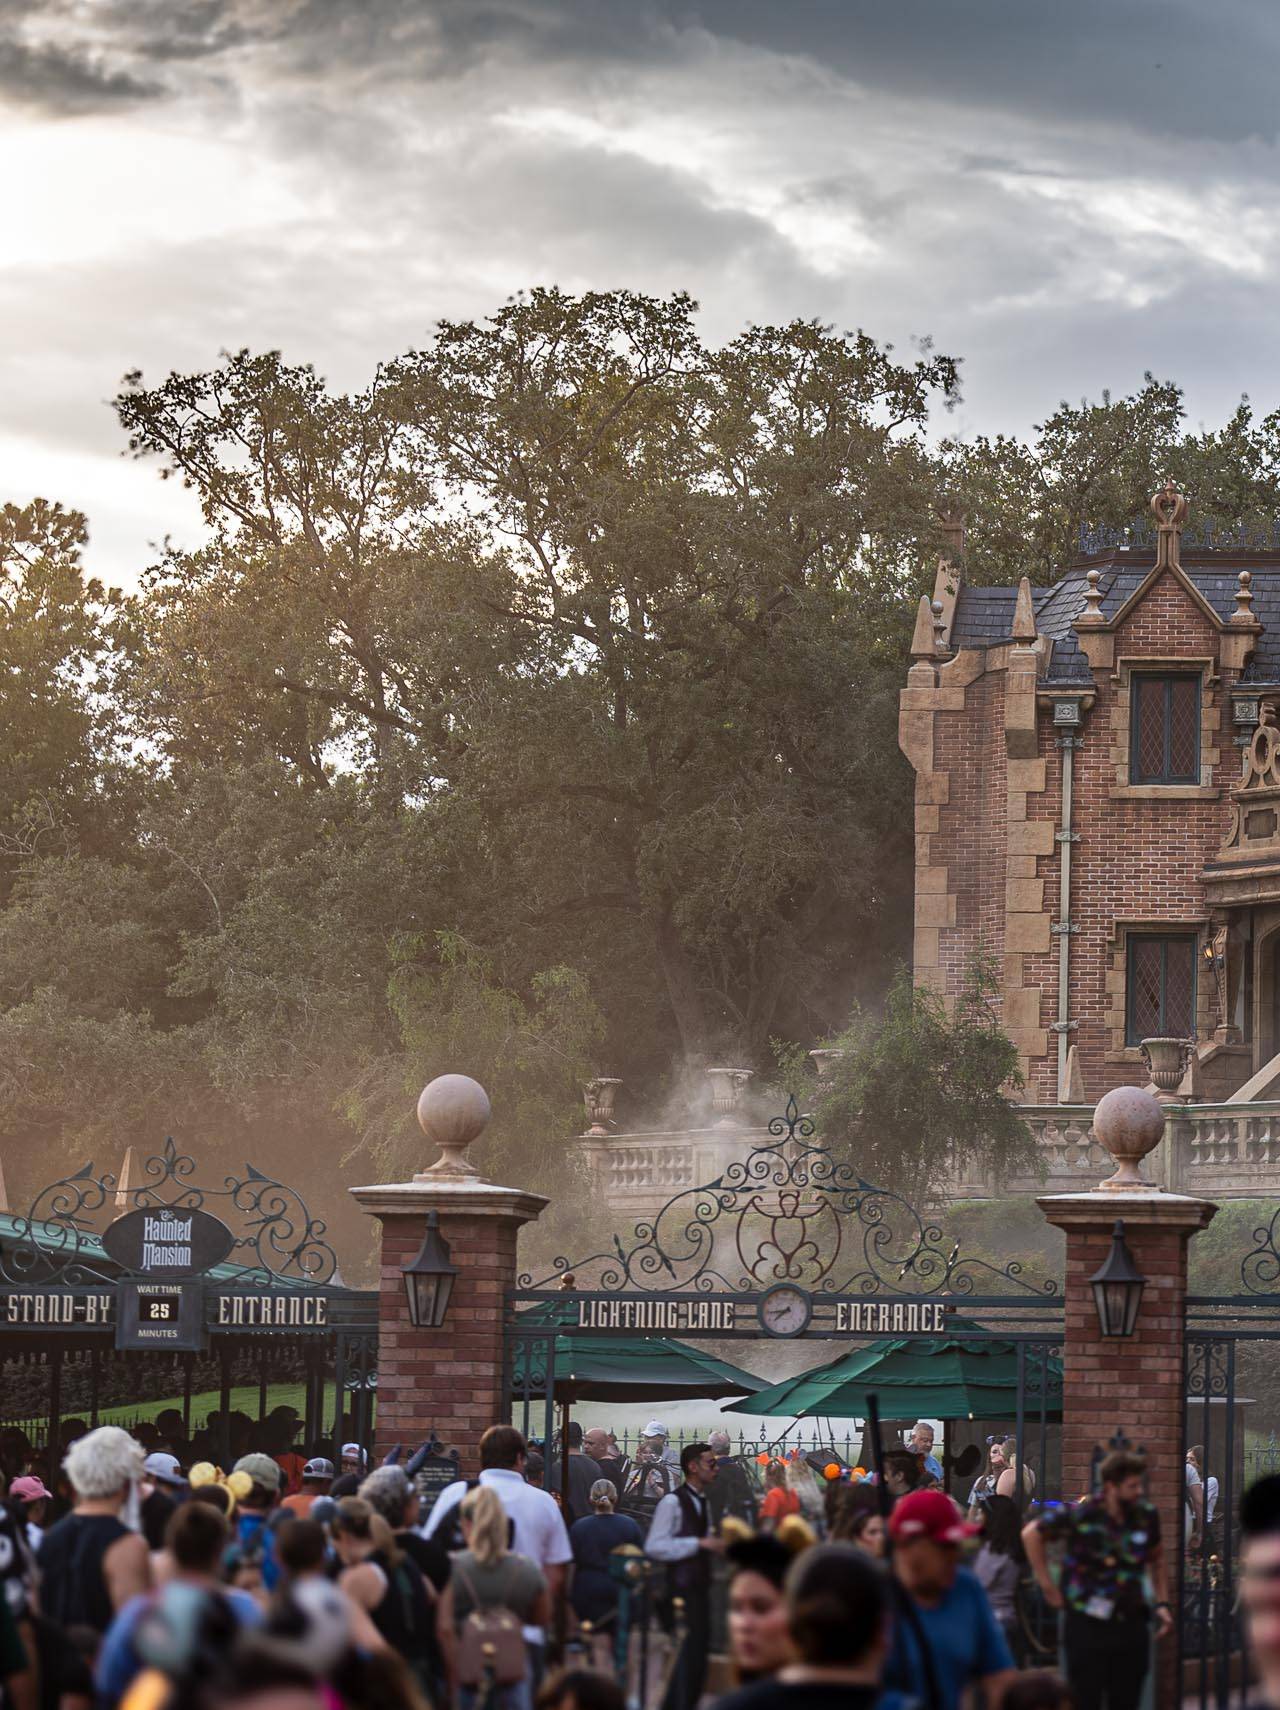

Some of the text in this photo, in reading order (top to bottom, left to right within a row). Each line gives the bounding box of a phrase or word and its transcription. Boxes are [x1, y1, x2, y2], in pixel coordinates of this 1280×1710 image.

[143, 1216, 193, 1242] Haunted
[140, 1242, 192, 1271] Mansion
[137, 1285, 182, 1294] WAIT TIME
[7, 1294, 111, 1323] STAND-BY
[150, 1303, 170, 1319] 25
[218, 1296, 327, 1325] ENTRANCE
[578, 1300, 734, 1329] LIGHTNING LANE
[836, 1303, 945, 1332] ENTRANCE
[138, 1329, 178, 1338] MINUTES
